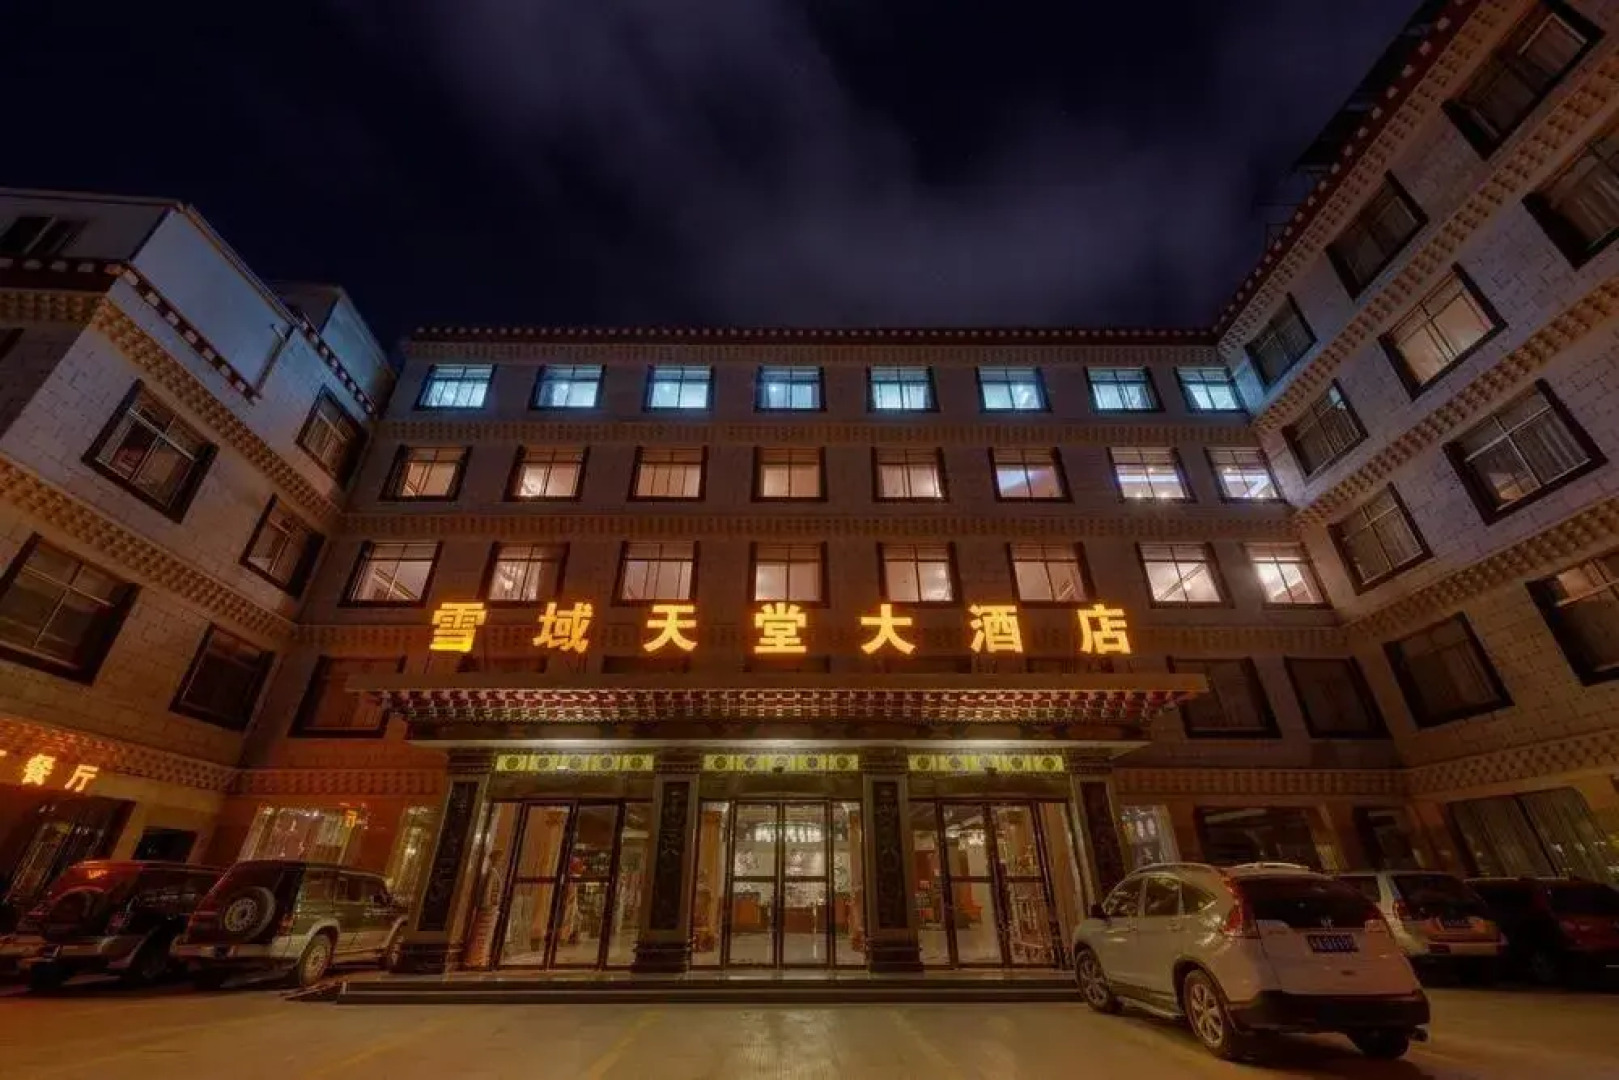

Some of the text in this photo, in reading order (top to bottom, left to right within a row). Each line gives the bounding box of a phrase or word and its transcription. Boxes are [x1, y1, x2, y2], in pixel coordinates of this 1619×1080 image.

[429, 602, 1131, 654] 雪域天堂大酒店
[0, 750, 99, 792] 餐厅
